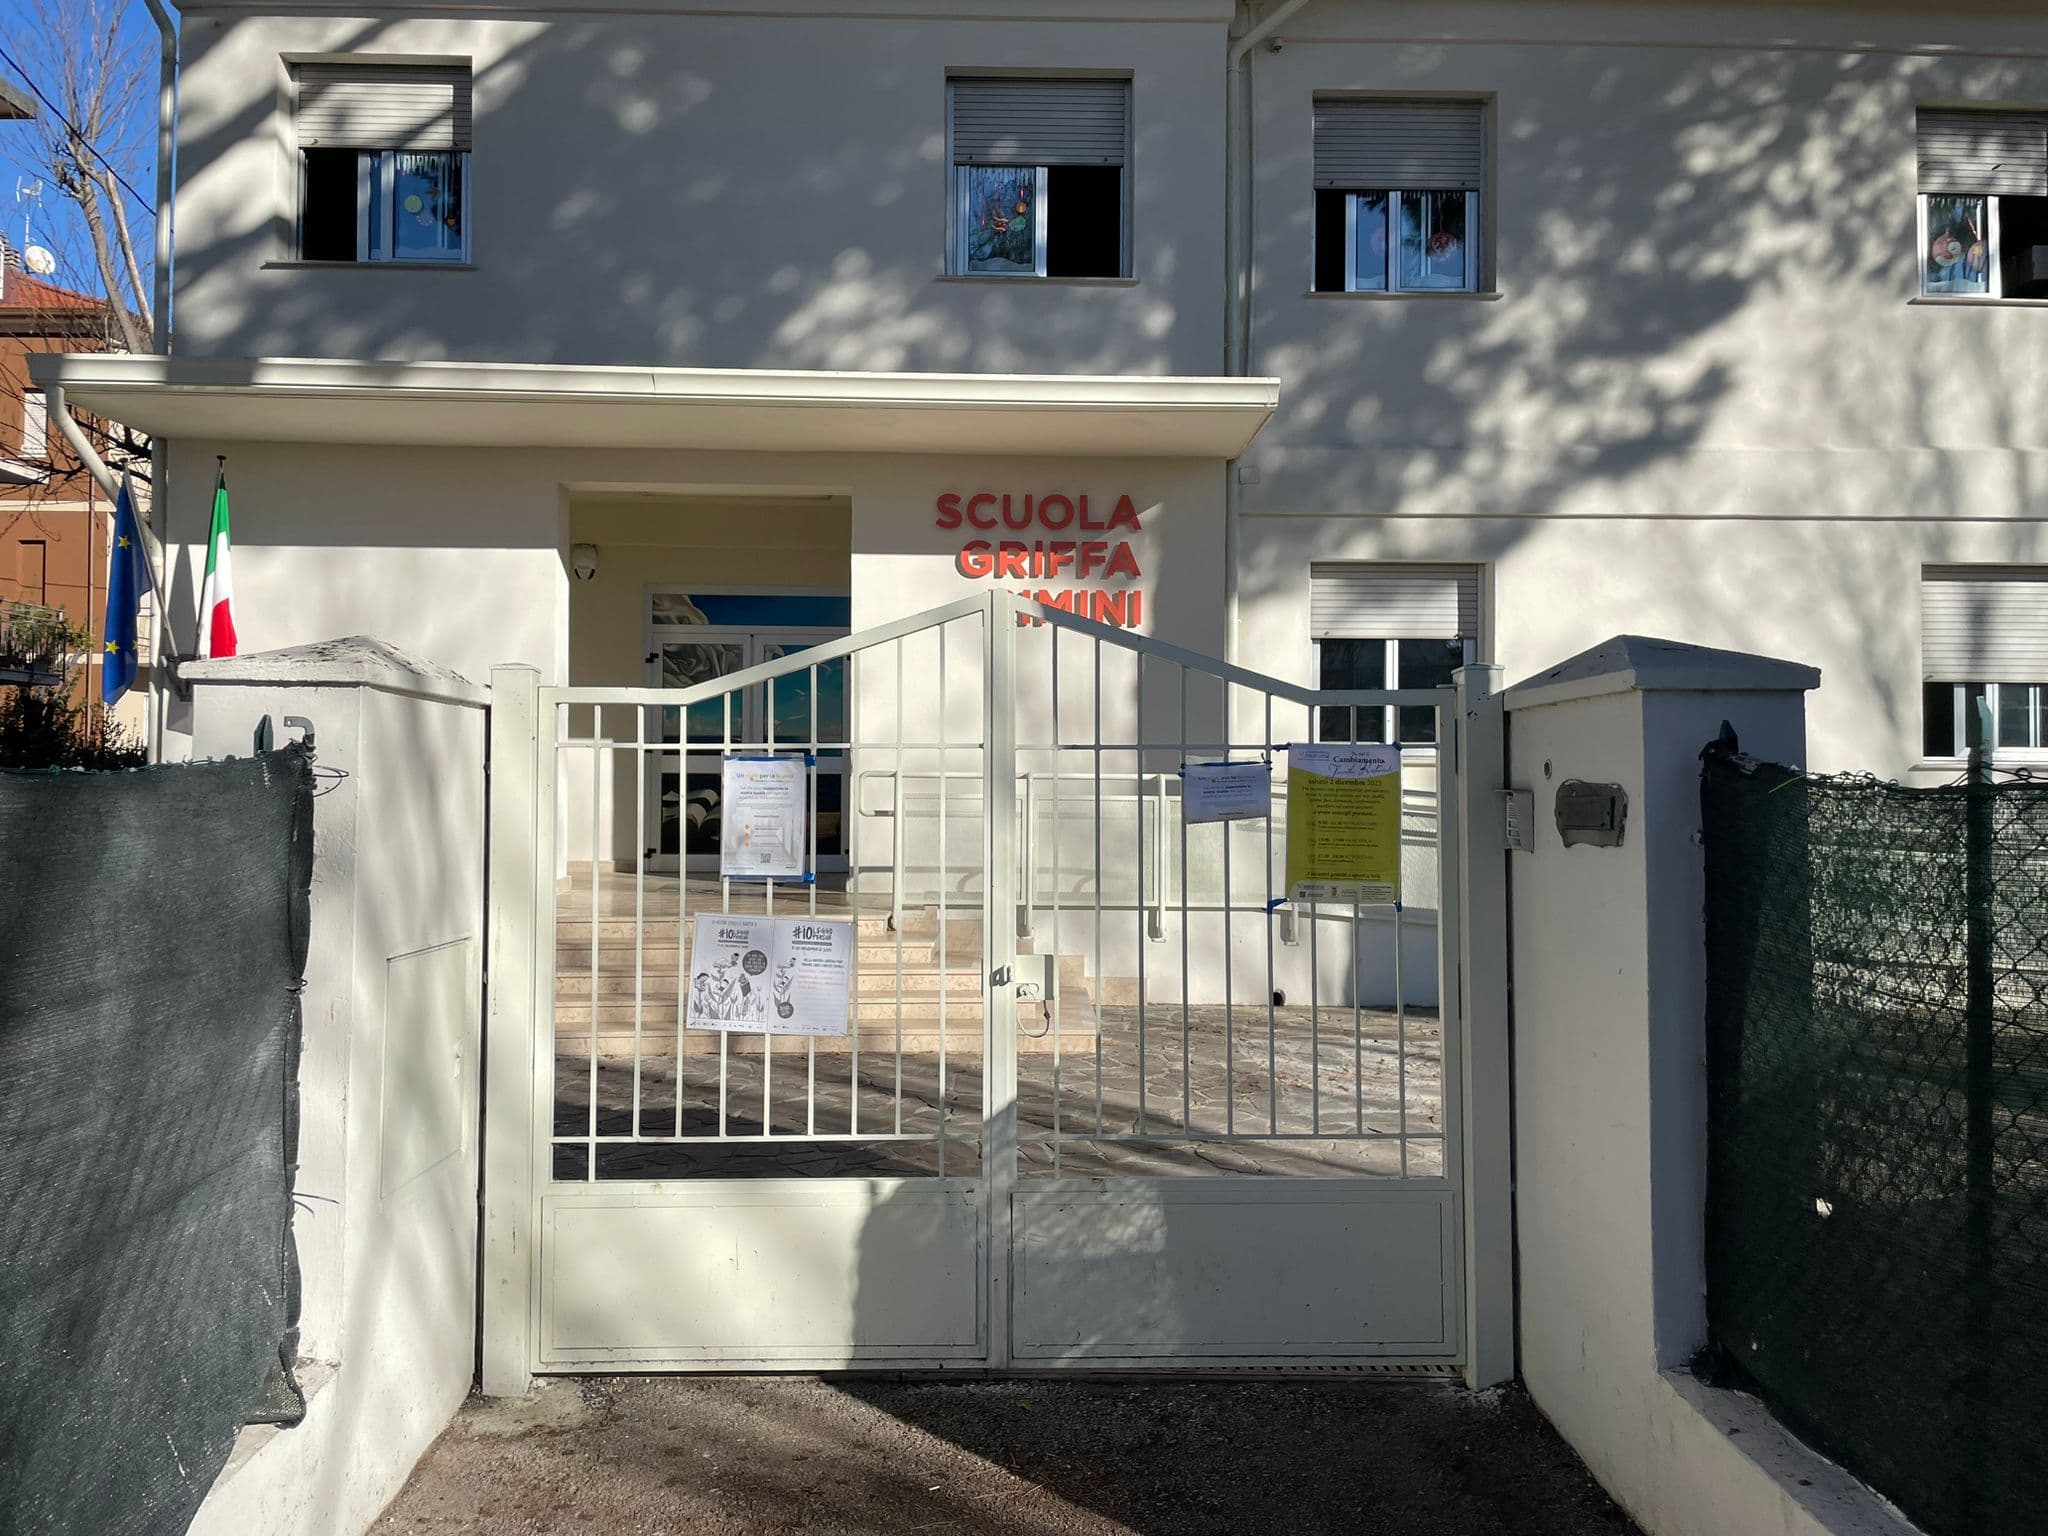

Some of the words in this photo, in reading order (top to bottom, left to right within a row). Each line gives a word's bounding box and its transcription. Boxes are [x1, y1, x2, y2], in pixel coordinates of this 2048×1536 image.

[936, 493, 1142, 530] SCUOLA
[959, 540, 1141, 577] GRIFFA
[988, 589, 1141, 627] IMINI
